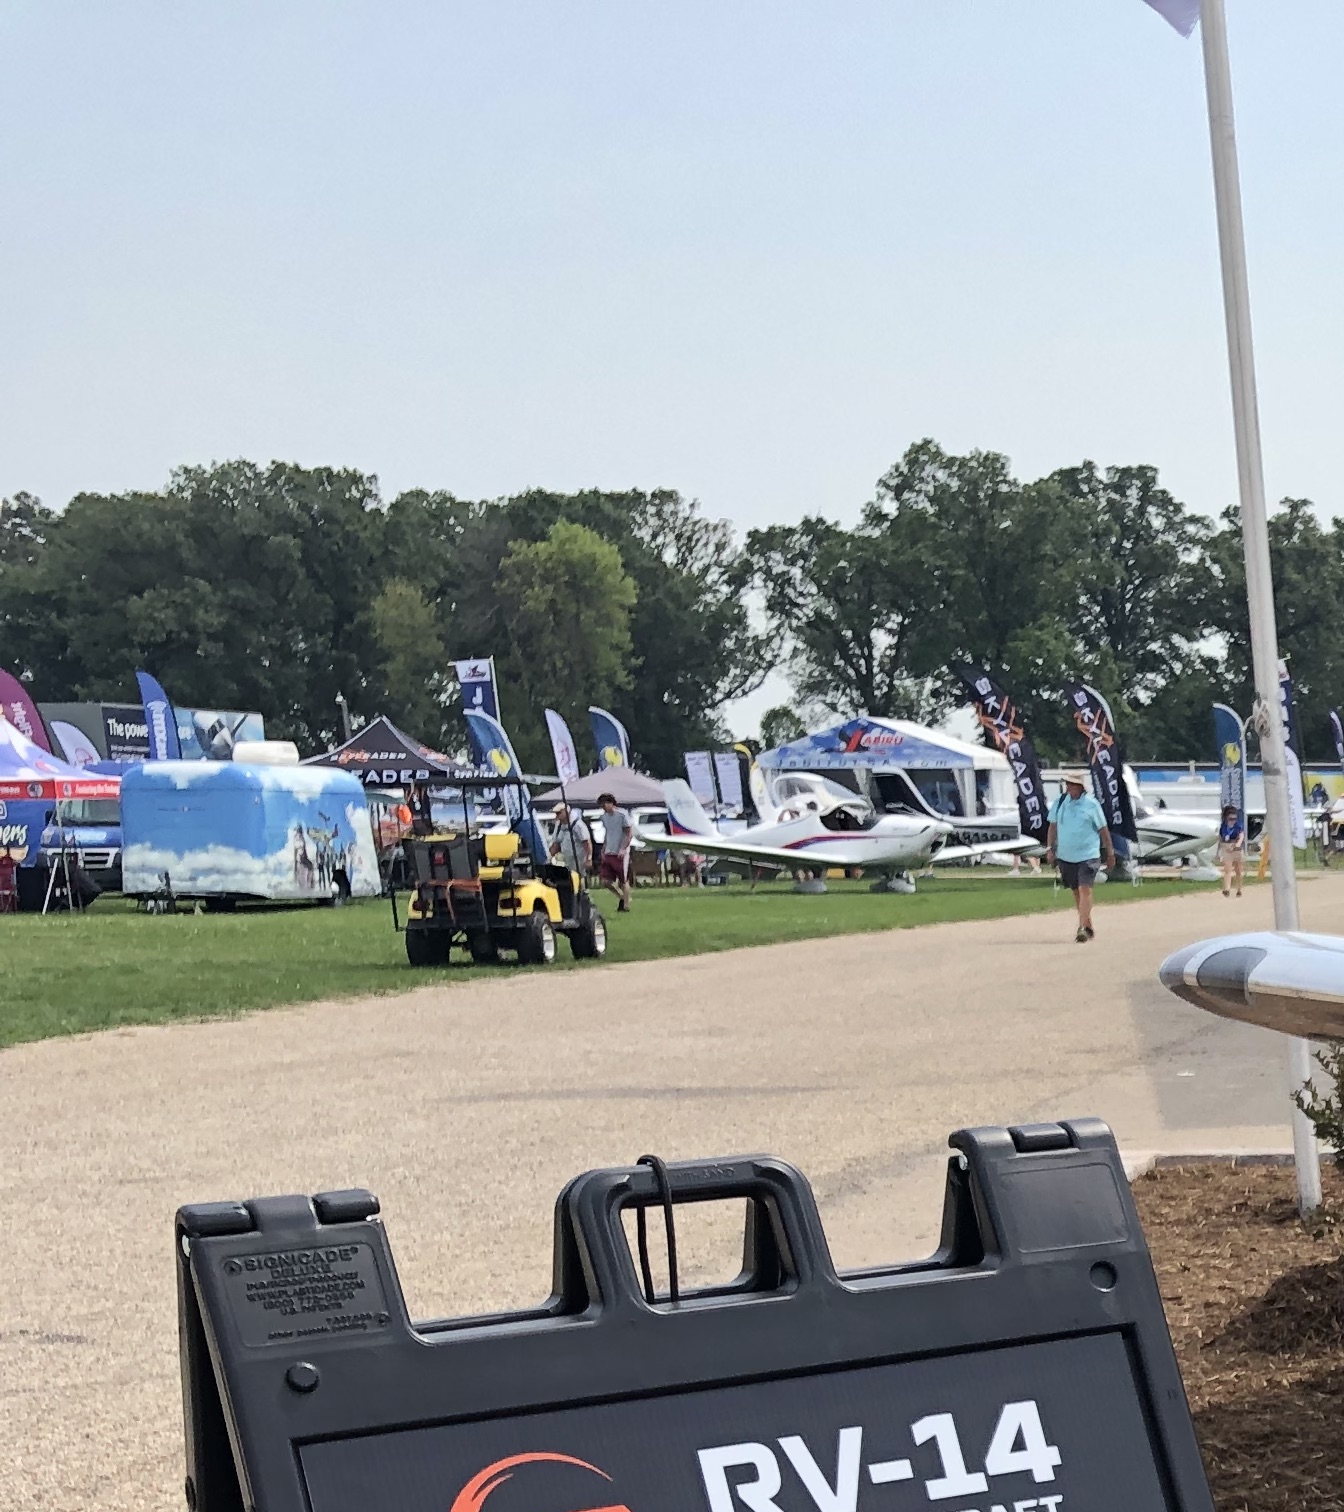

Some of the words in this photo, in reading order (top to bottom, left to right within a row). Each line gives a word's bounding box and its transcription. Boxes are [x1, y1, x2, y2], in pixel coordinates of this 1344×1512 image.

[107, 718, 124, 737] The
[975, 677, 1042, 830] SKYLEADER
[1073, 691, 1123, 825] SKYLEADER
[271, 1264, 332, 1279] DELUXE
